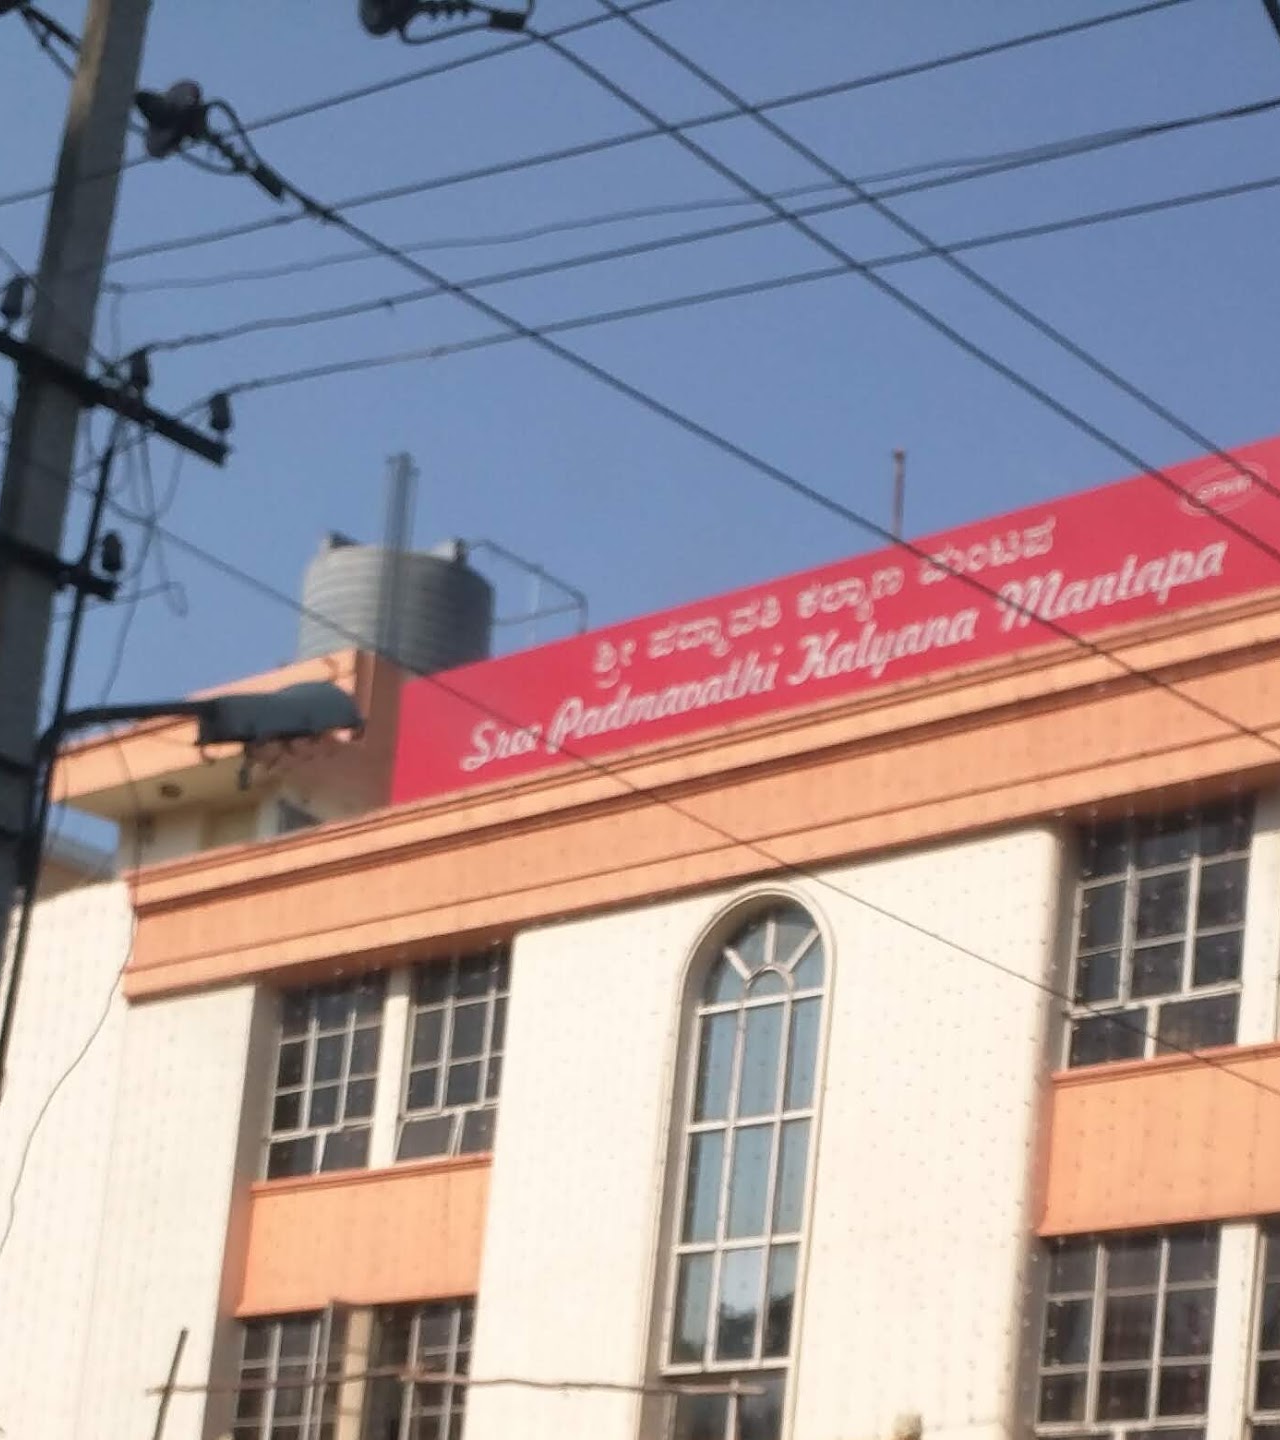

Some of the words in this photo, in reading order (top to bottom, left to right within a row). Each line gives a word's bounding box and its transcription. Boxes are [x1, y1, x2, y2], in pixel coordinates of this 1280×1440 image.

[459, 719, 543, 772] Sree
[546, 644, 784, 755] Padmavathi
[787, 607, 980, 687] Kalyana
[996, 540, 1229, 633] Mantapa
[593, 638, 637, 689] ಶ್ರೀ
[796, 566, 906, 622] ಕಲ್ಯಾಣ
[919, 516, 1057, 586] ಮಂಟಪ
